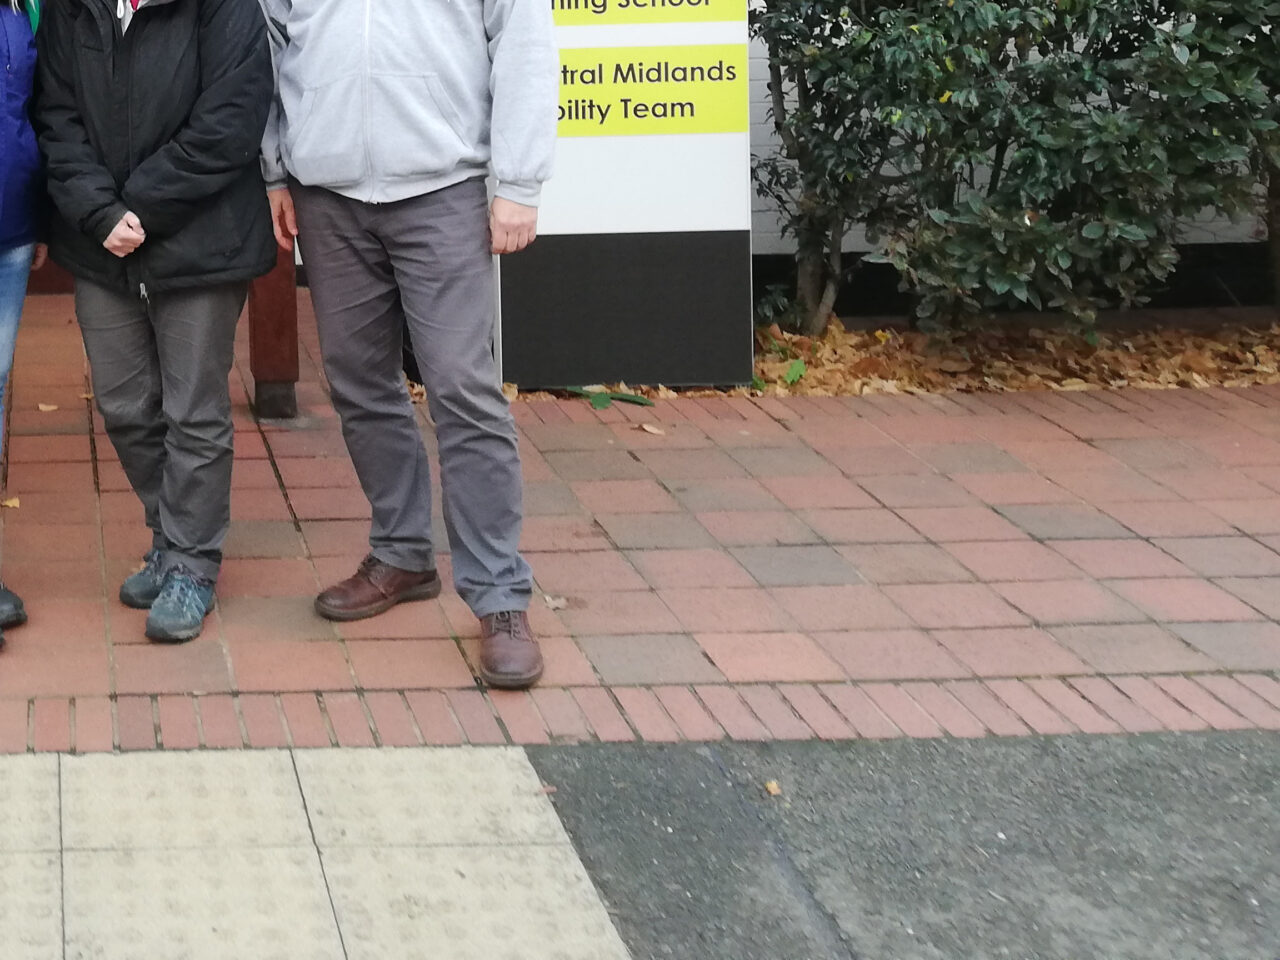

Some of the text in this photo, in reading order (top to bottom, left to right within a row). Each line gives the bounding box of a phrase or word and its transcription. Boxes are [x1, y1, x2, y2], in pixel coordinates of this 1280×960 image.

[560, 60, 738, 85] tral Midlands
[620, 98, 696, 119] Team
